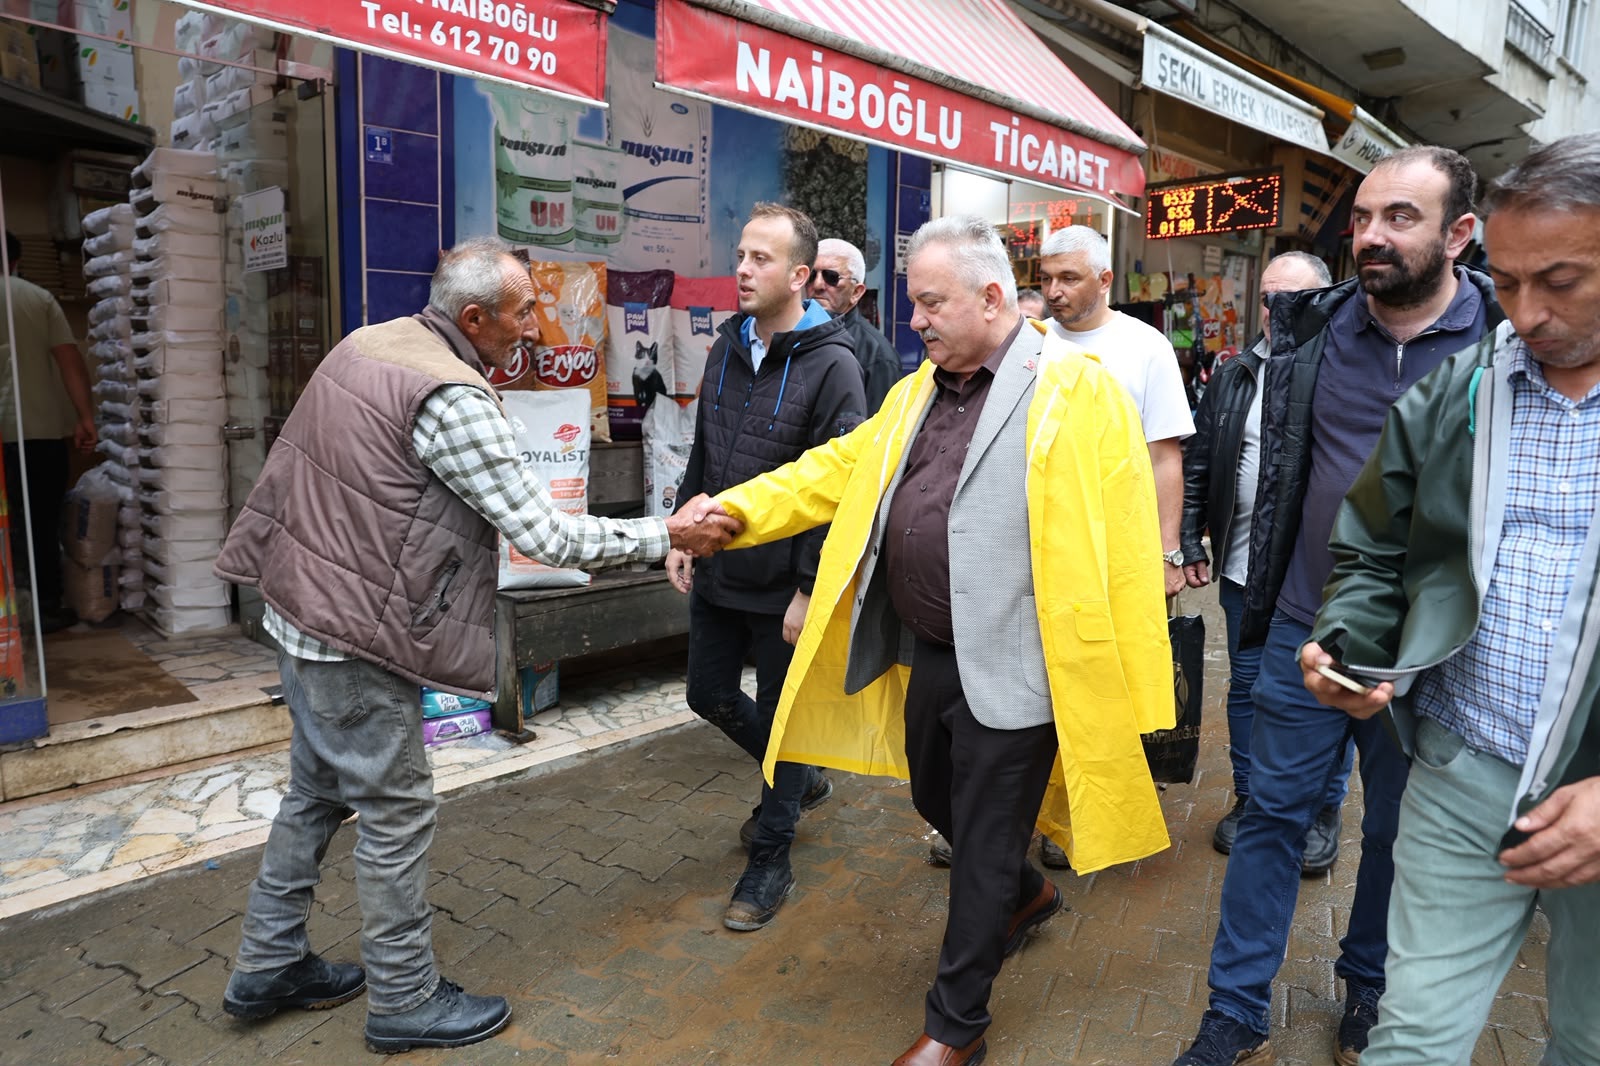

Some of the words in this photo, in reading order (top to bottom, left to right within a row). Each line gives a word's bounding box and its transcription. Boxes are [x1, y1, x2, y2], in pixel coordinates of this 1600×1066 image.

[360, 1, 422, 41] Tel:
[430, 21, 481, 56] 612
[488, 35, 520, 66] 70
[527, 47, 557, 75] 90
[1158, 53, 1206, 101] ŞEKİL
[1212, 79, 1256, 119] ERKEK
[736, 41, 962, 150] NAİBOĞLU
[990, 117, 1110, 191] TİCARET
[1163, 190, 1196, 207] 0532
[530, 199, 565, 228] UN
[595, 214, 617, 231] UN
[256, 232, 283, 246] Kozlu
[1159, 221, 1175, 235] 01
[536, 349, 597, 382] Enjoy
[517, 450, 585, 464] OYALIST
